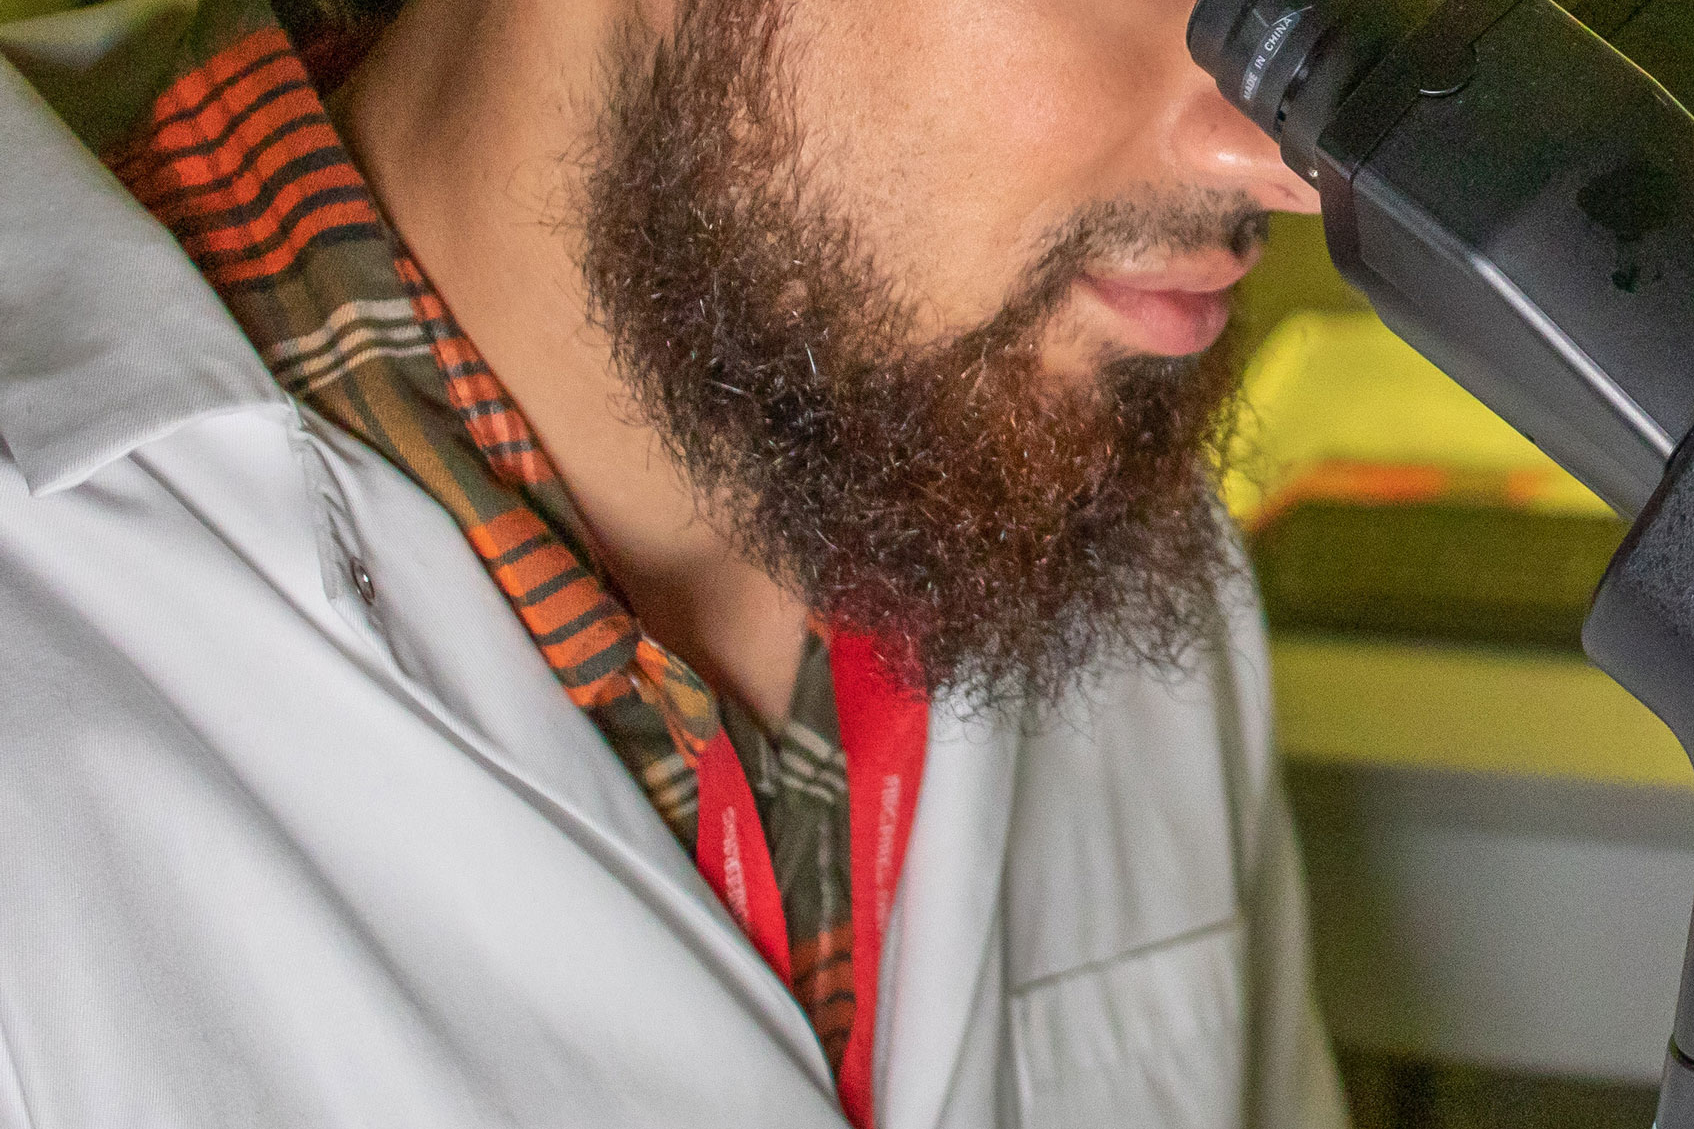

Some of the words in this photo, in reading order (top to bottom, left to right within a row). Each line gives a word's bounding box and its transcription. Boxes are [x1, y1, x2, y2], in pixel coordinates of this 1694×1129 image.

[1243, 72, 1258, 100] MADE
[1254, 56, 1266, 69] IN
[1264, 18, 1293, 52] CHINA
